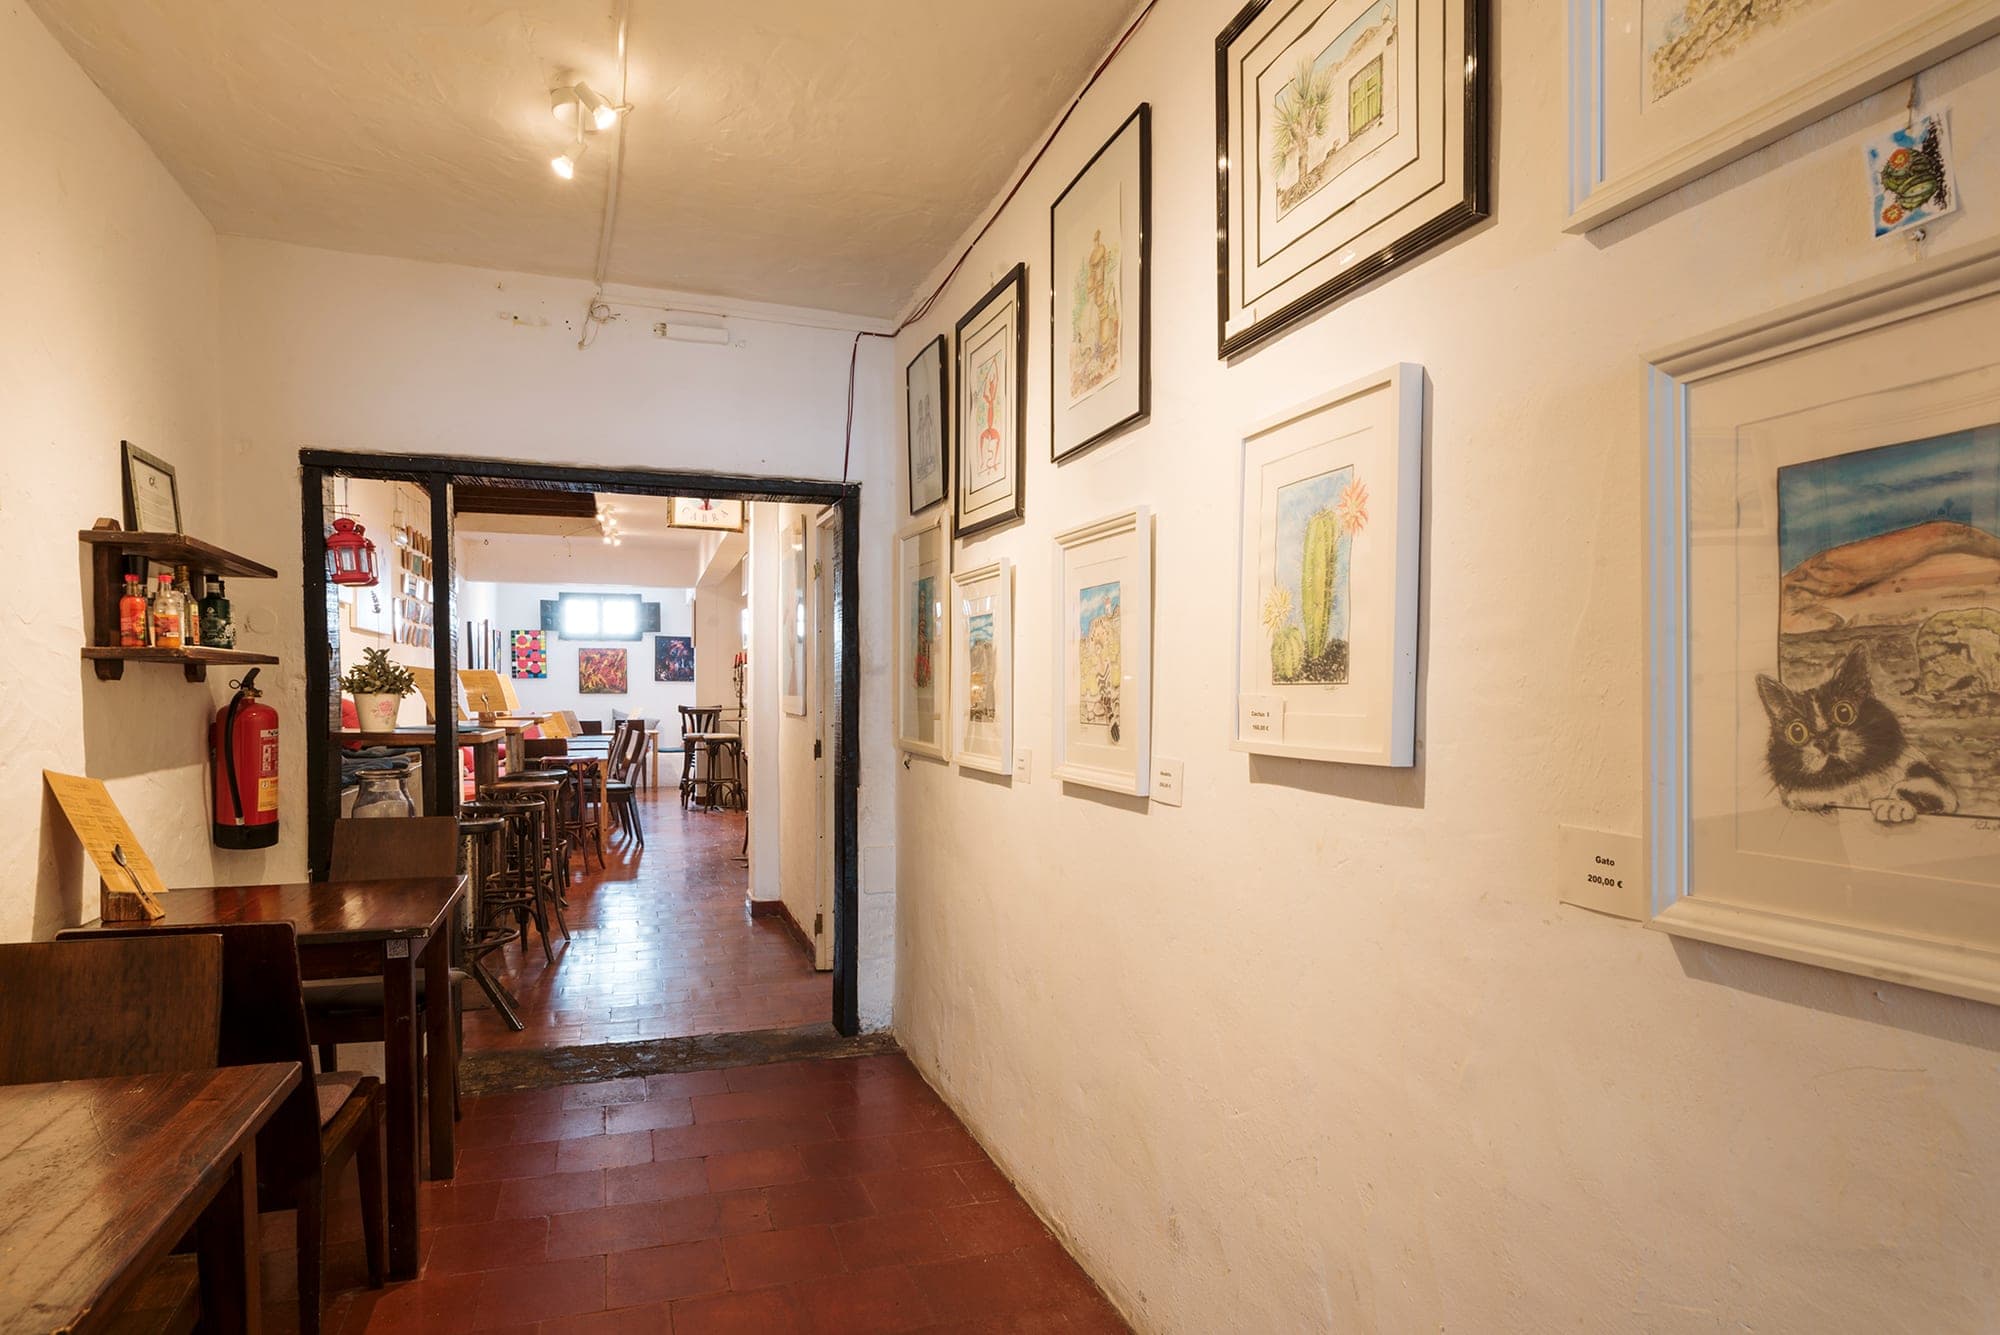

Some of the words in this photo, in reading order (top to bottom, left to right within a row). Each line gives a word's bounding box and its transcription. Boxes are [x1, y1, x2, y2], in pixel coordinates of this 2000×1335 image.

[1595, 855, 1615, 866] Gato
[1588, 874, 1615, 887] 200,00
[1617, 880, 1623, 889] €
